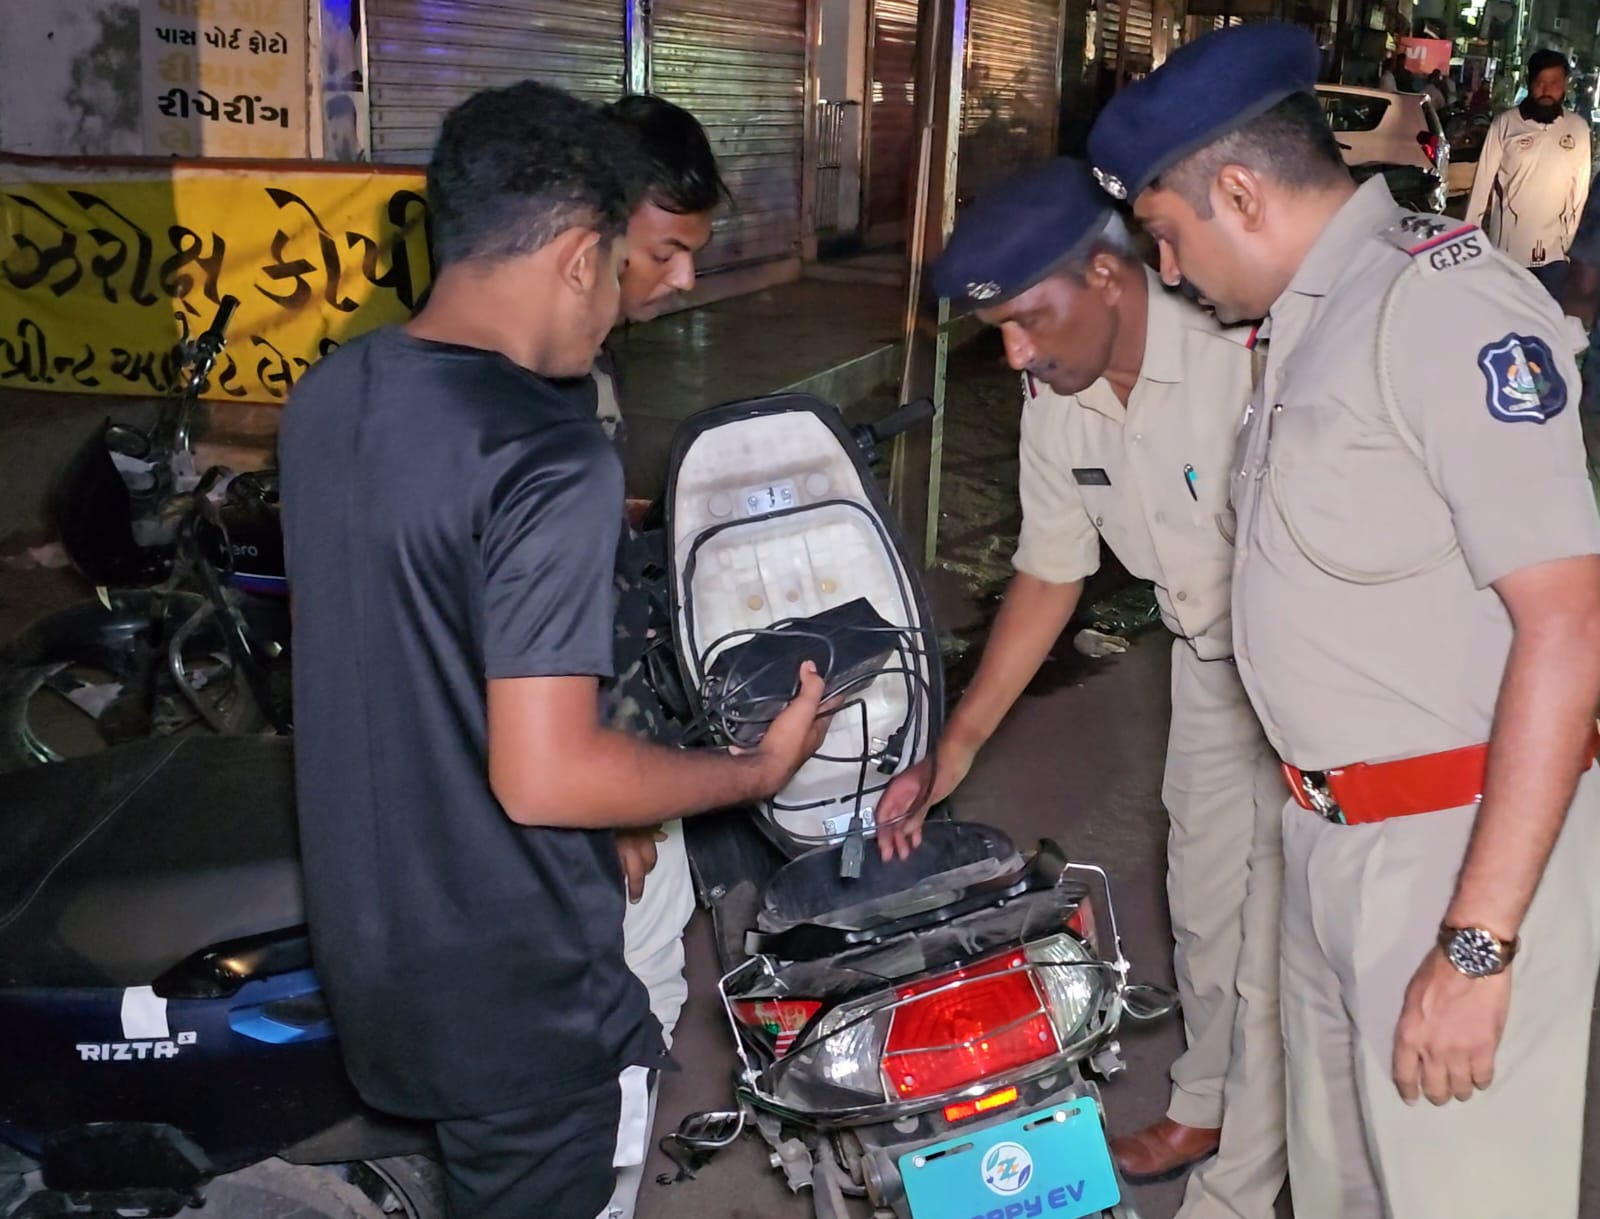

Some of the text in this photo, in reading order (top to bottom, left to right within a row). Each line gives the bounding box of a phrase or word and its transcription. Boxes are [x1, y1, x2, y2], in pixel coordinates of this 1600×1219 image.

[155, 26, 288, 54] પાસ પોર્ટ ફોટો
[157, 88, 289, 128] રીપેરીંગ
[75, 1041, 179, 1061] RIZTA
[1047, 1179, 1085, 1209] EV
